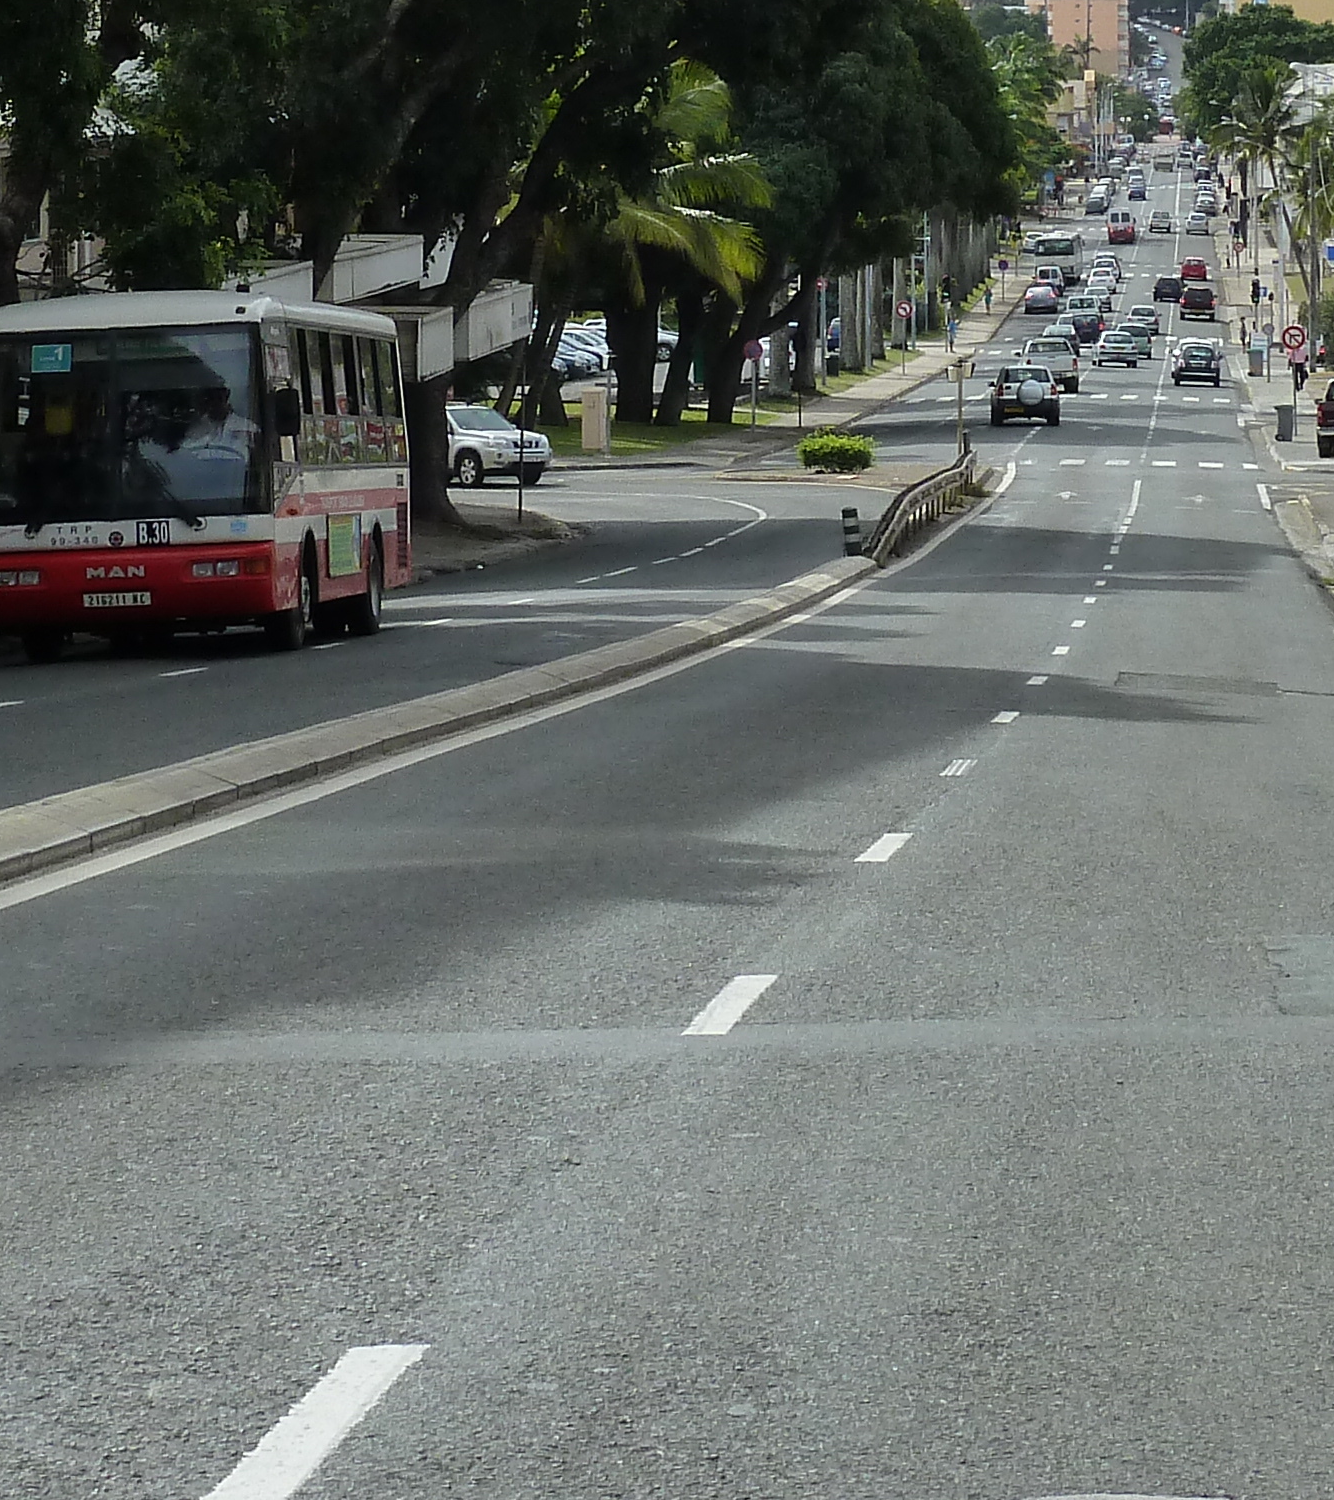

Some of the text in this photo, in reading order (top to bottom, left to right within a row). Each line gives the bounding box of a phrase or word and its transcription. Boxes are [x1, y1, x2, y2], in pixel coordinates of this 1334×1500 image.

[139, 522, 168, 544] B.30
[86, 565, 145, 579] MAN
[132, 593, 146, 604] NC
